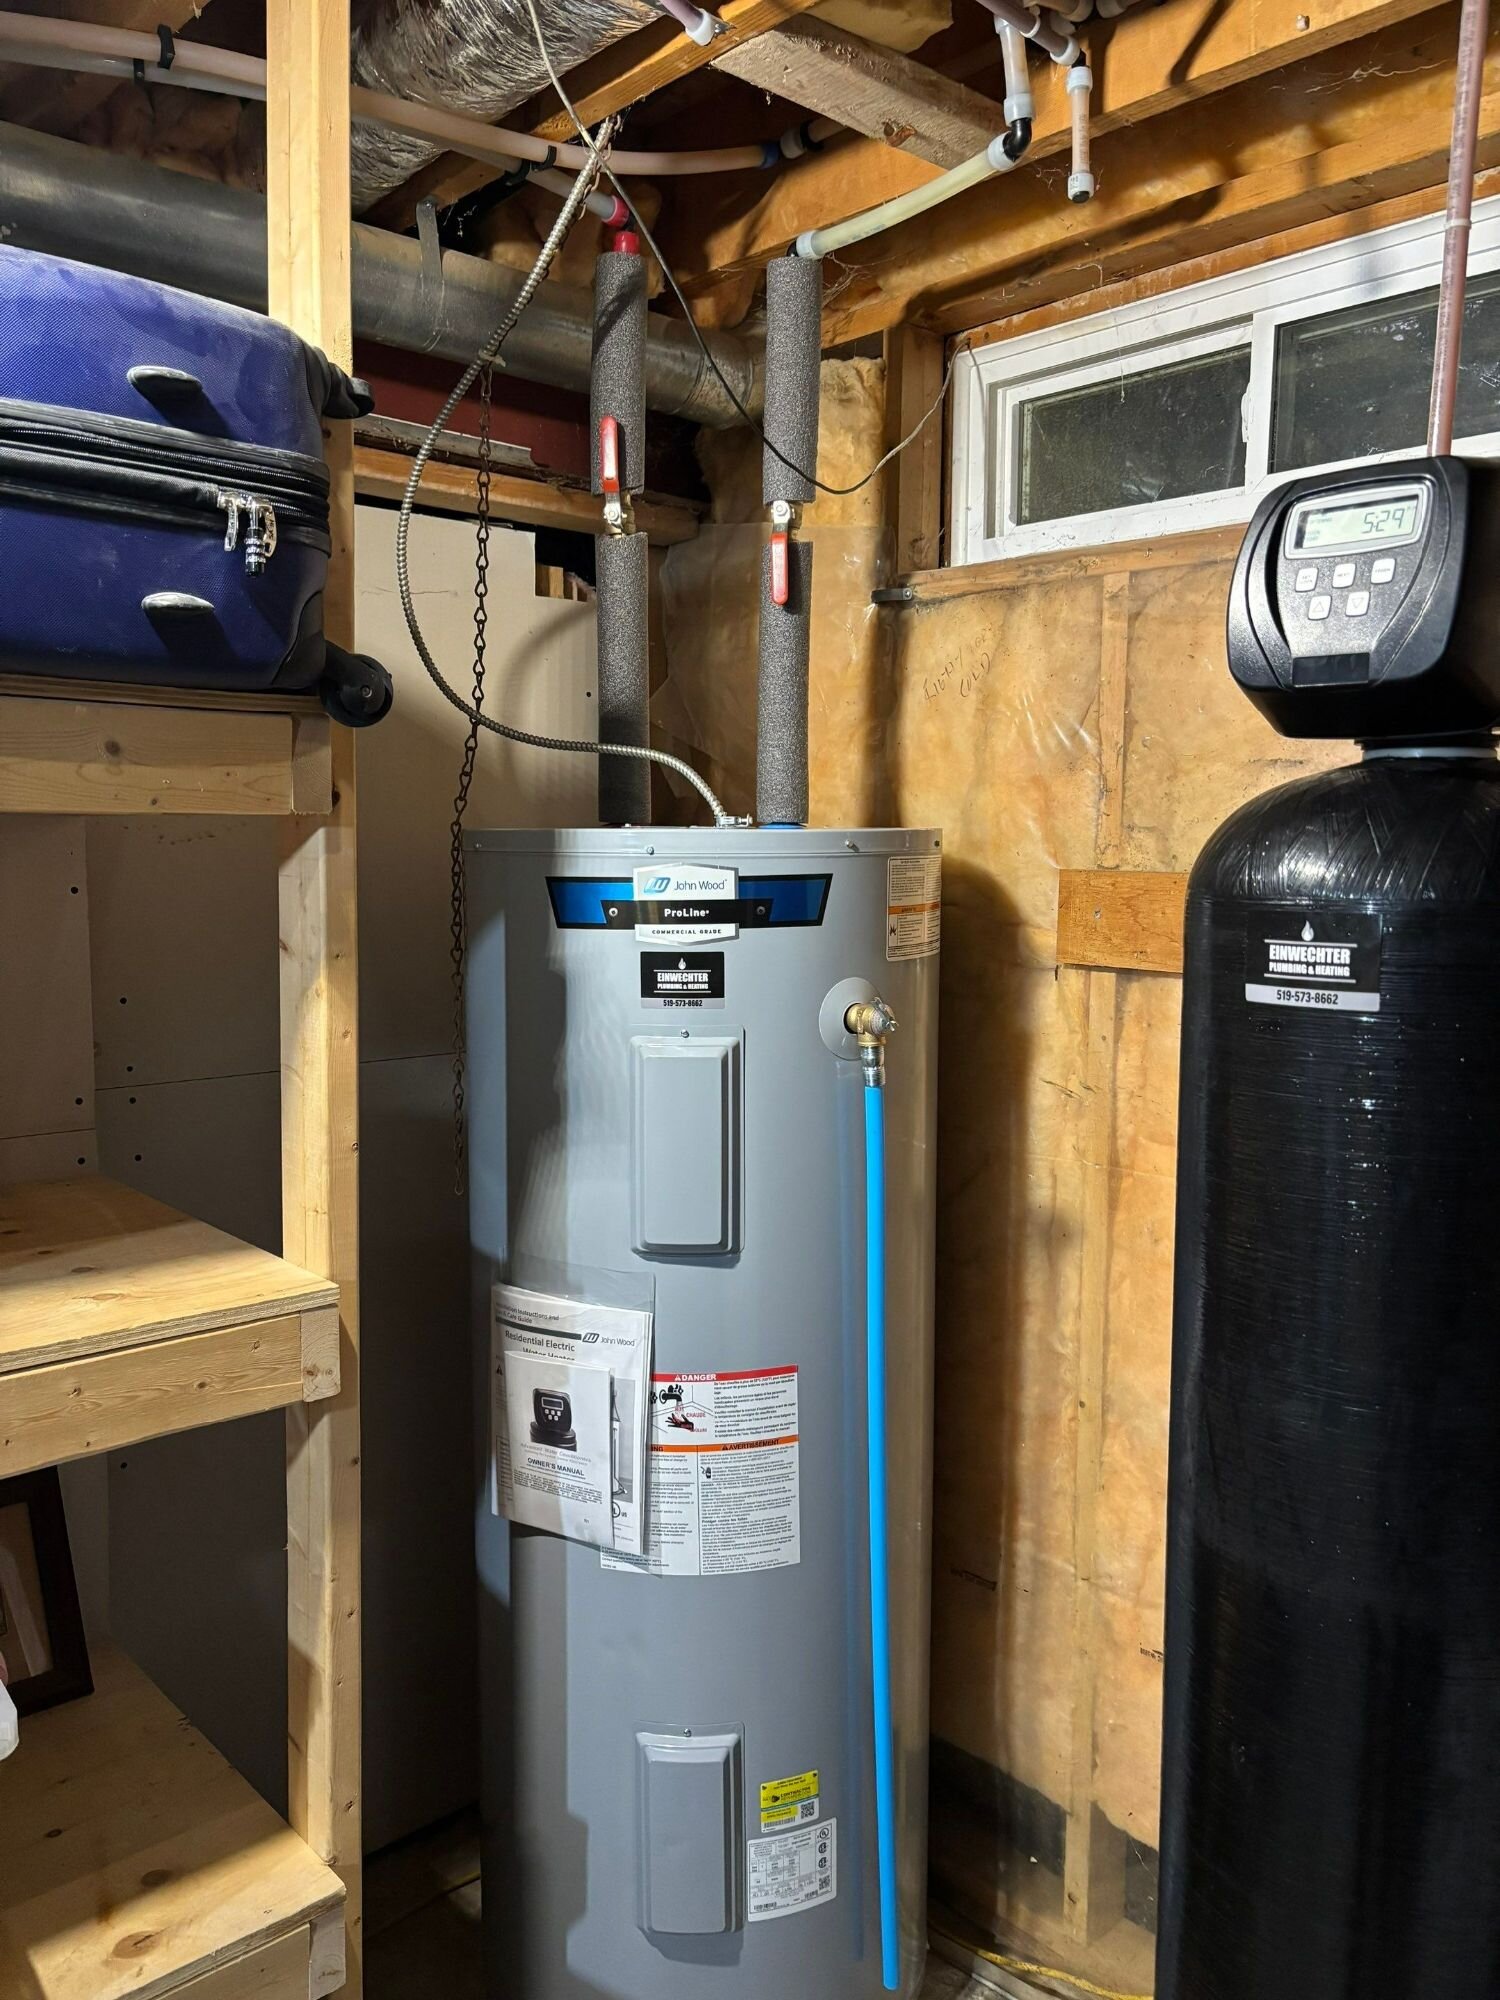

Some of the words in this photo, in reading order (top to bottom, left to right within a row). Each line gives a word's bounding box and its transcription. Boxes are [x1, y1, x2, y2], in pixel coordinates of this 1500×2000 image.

[1361, 508, 1405, 534] 5:29
[673, 880, 697, 891] John
[698, 880, 725, 890] Wood
[664, 908, 706, 917] ProLine
[1269, 944, 1350, 964] EINWECHTER
[1269, 961, 1307, 975] PLUMBING
[1307, 965, 1314, 975] &
[1315, 965, 1350, 977] HEATING
[657, 972, 709, 983] EINWECHTER
[1276, 989, 1339, 1005] 519-573-8662
[505, 1330, 544, 1347] Residential
[546, 1341, 576, 1352] Electric
[600, 1337, 616, 1345] John
[616, 1338, 635, 1347] Wood
[681, 1373, 717, 1381] DANGER
[728, 1439, 780, 1450] AVERTISSEMENT
[527, 1457, 556, 1470] OWNER'S
[556, 1465, 585, 1476] MANUAL
